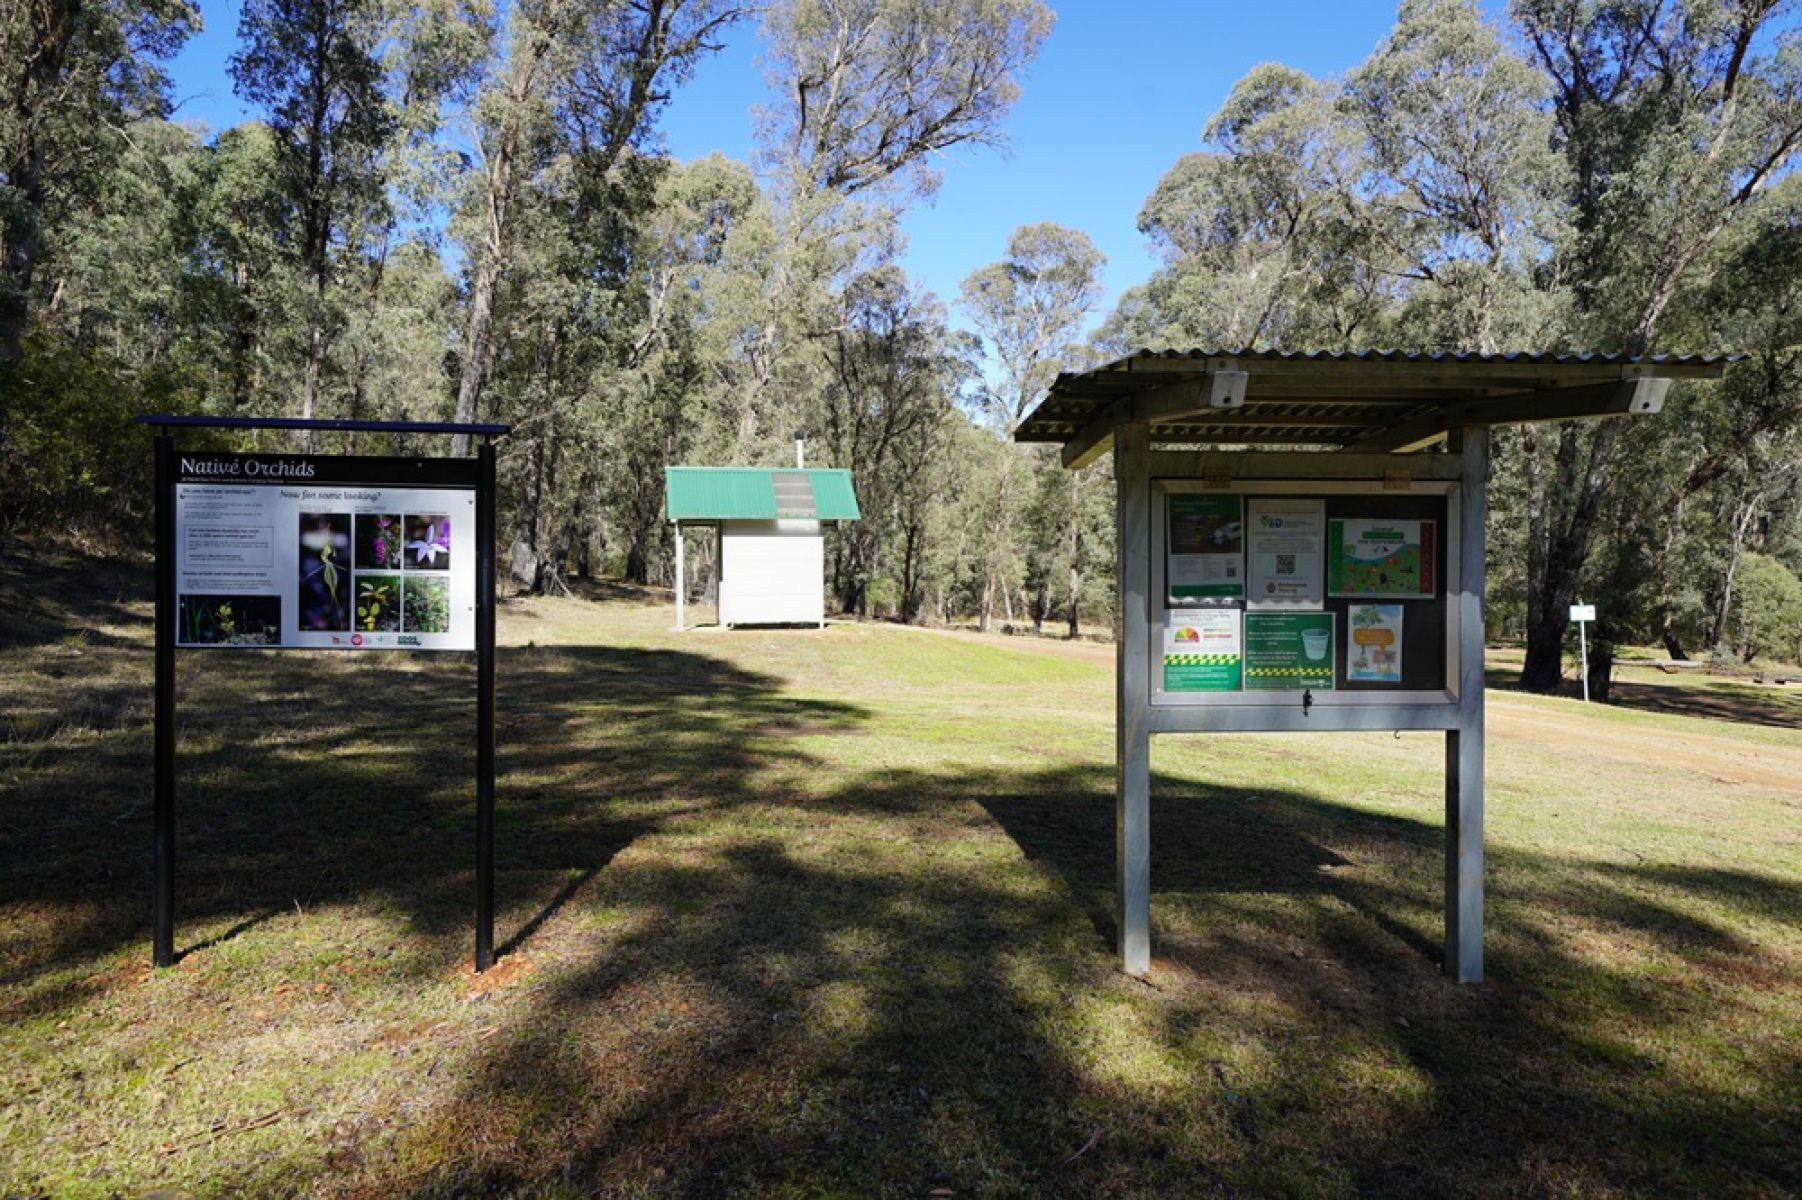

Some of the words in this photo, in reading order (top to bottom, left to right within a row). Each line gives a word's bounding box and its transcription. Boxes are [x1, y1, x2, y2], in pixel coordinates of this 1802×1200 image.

[181, 457, 241, 475] Native
[244, 458, 315, 477] Orchids
[280, 489, 299, 498] Now
[302, 490, 316, 501] for
[318, 492, 342, 500] some
